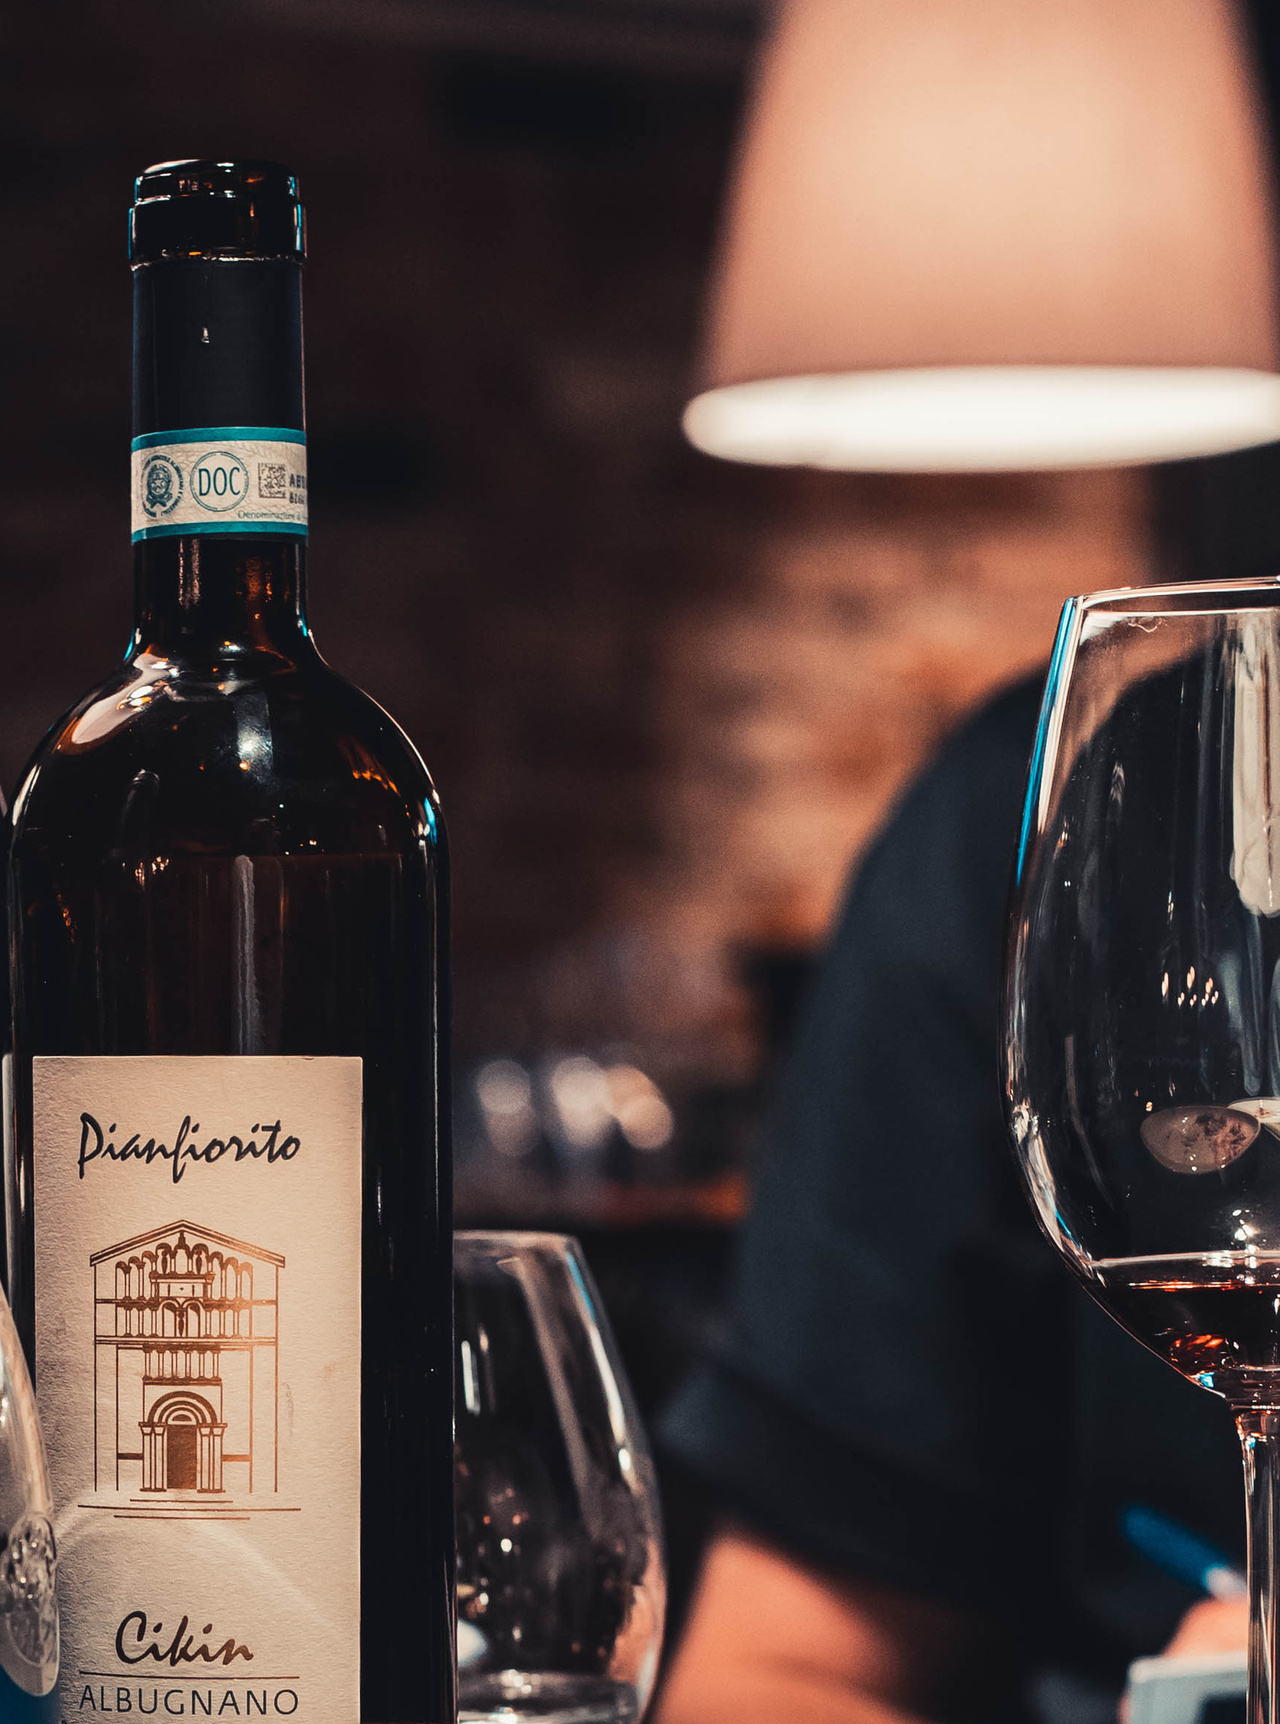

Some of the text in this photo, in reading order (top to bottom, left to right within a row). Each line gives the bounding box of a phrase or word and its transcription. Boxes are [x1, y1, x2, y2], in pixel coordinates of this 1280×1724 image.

[198, 467, 241, 496] DOC
[77, 1112, 301, 1184] Pianfiorito
[115, 1610, 255, 1667] Cikin
[79, 1684, 299, 1716] ALBUGNANO
